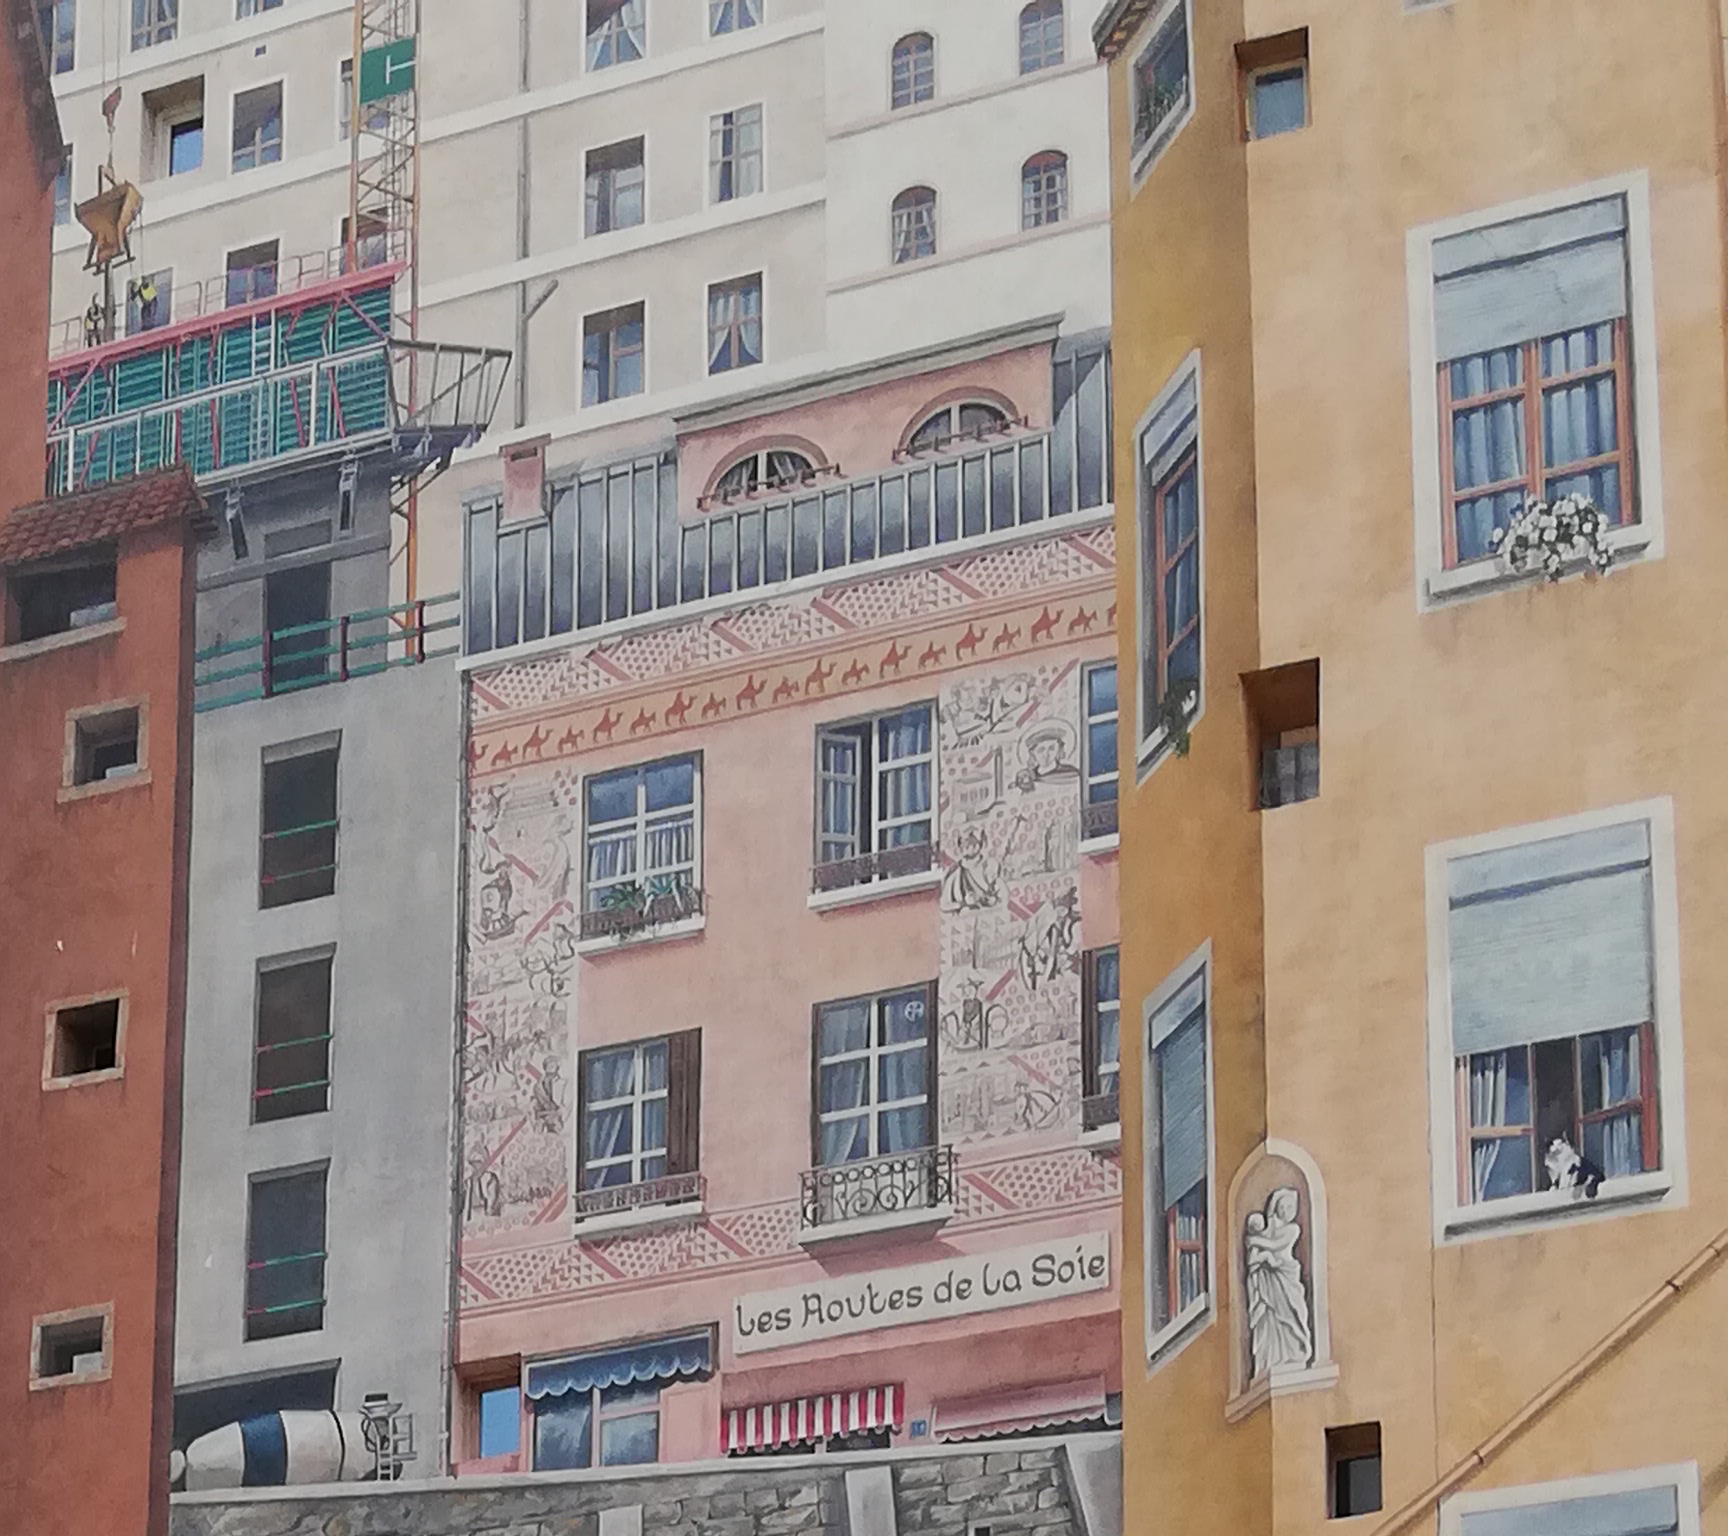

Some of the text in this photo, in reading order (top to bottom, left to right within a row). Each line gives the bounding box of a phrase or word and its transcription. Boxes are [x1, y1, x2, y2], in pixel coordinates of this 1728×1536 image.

[735, 1303, 792, 1337] Les
[801, 1281, 923, 1328] Routes
[933, 1270, 973, 1303] de
[1031, 1245, 1106, 1287] Soie
